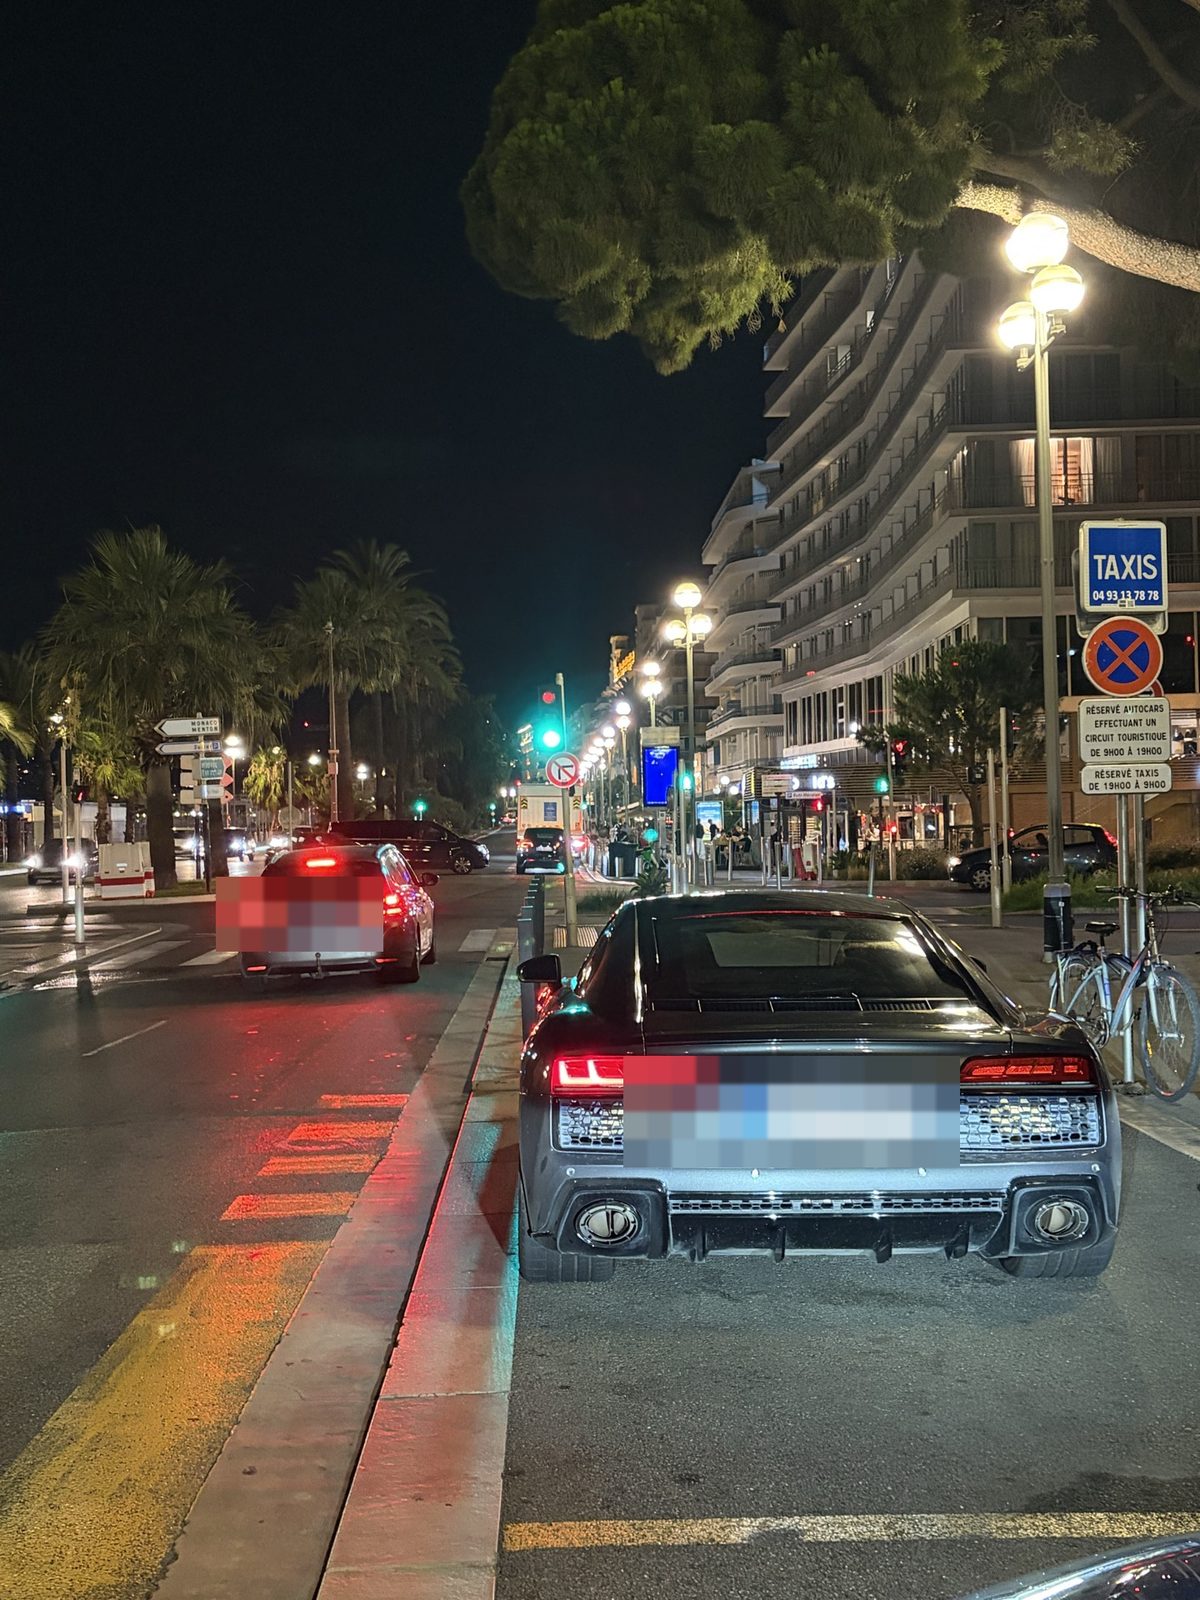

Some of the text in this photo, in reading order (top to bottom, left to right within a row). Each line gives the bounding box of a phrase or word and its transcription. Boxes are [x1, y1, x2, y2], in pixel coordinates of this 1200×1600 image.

[1093, 554, 1158, 580] TAXIS
[1092, 590, 1159, 601] 04 93 13 78 78
[1086, 704, 1164, 715] RÉSERVÉ AUTOCARS
[1094, 718, 1157, 728] EFFECTUANT UN
[1085, 732, 1167, 743] CIRCUIT TOURISTIQUE
[1090, 746, 1162, 757] DE 9H00 À 19H00
[1094, 768, 1159, 779] RÉSERVÉ TAXIS
[1089, 780, 1166, 791] DE 19H00 À 9H00
